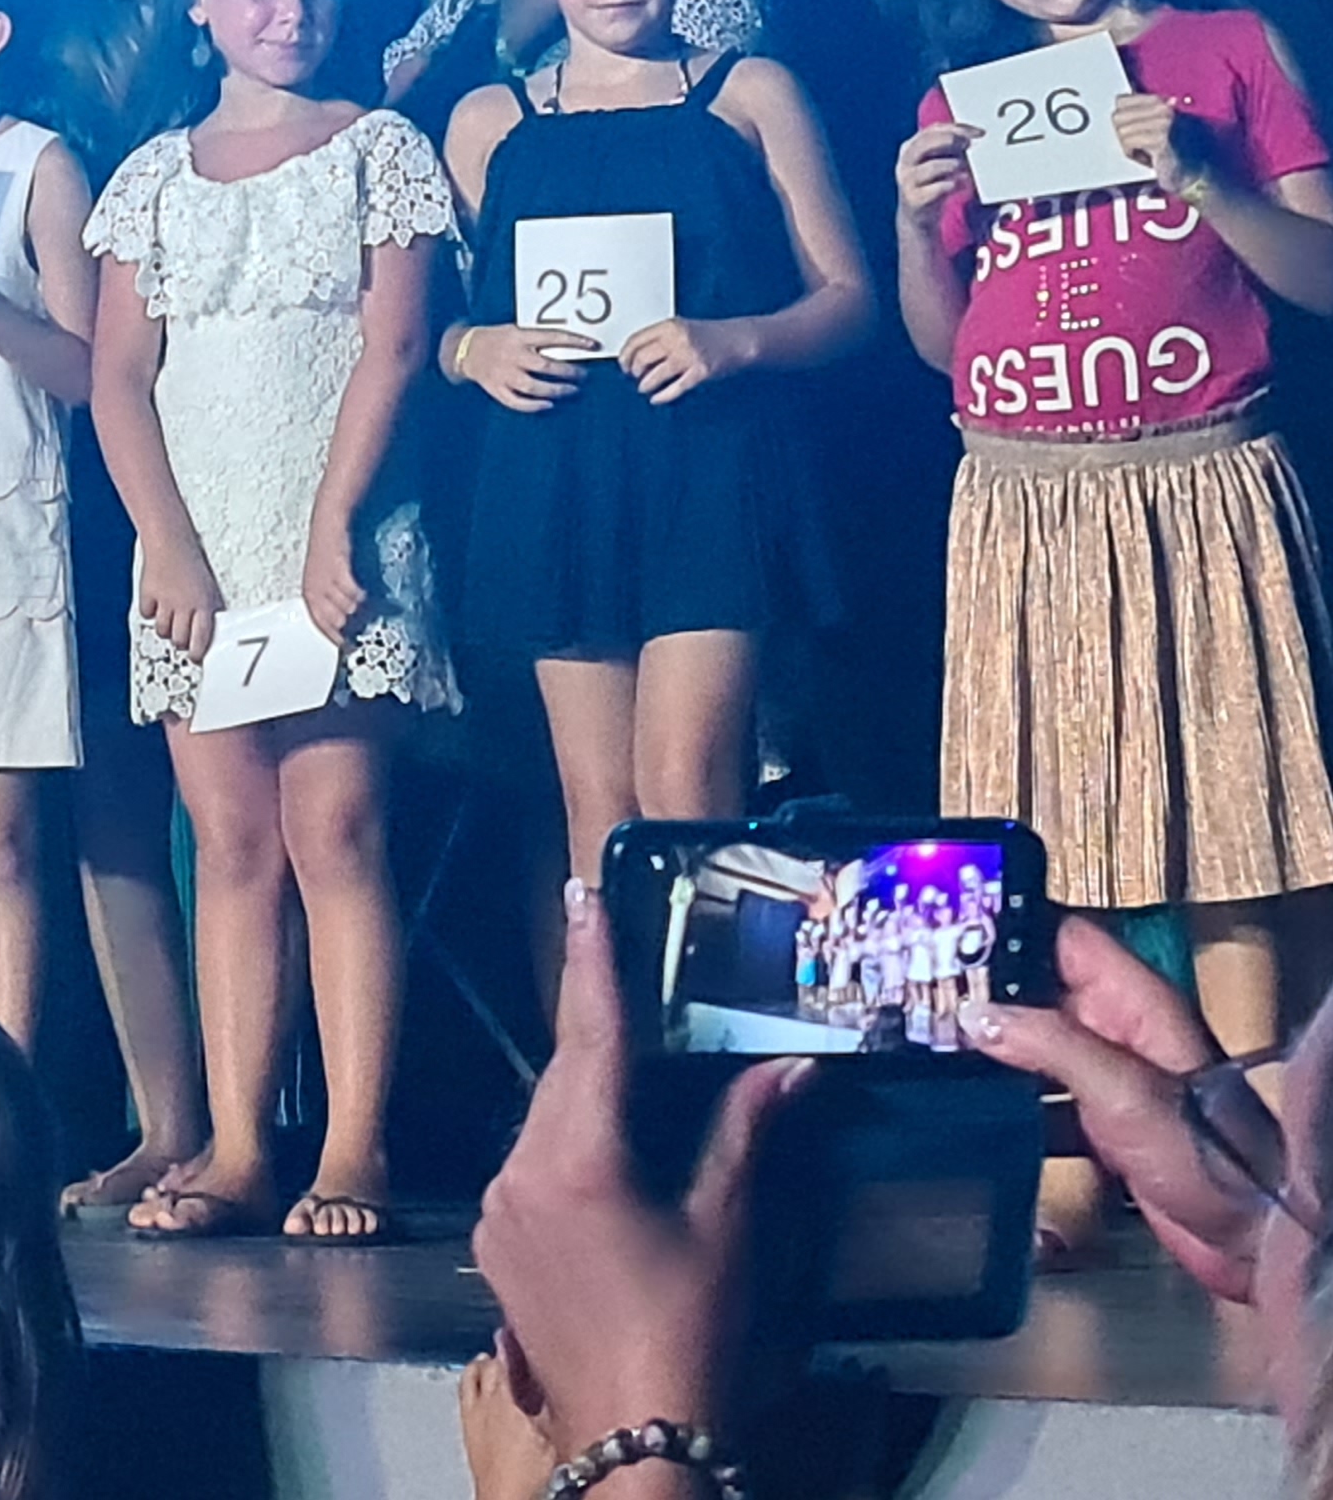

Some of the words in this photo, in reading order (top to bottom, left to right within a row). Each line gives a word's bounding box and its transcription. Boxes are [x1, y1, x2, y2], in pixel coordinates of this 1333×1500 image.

[997, 88, 1091, 145] 26
[535, 269, 613, 325] 25
[967, 326, 1211, 416] GUESS
[238, 636, 270, 687] 7
